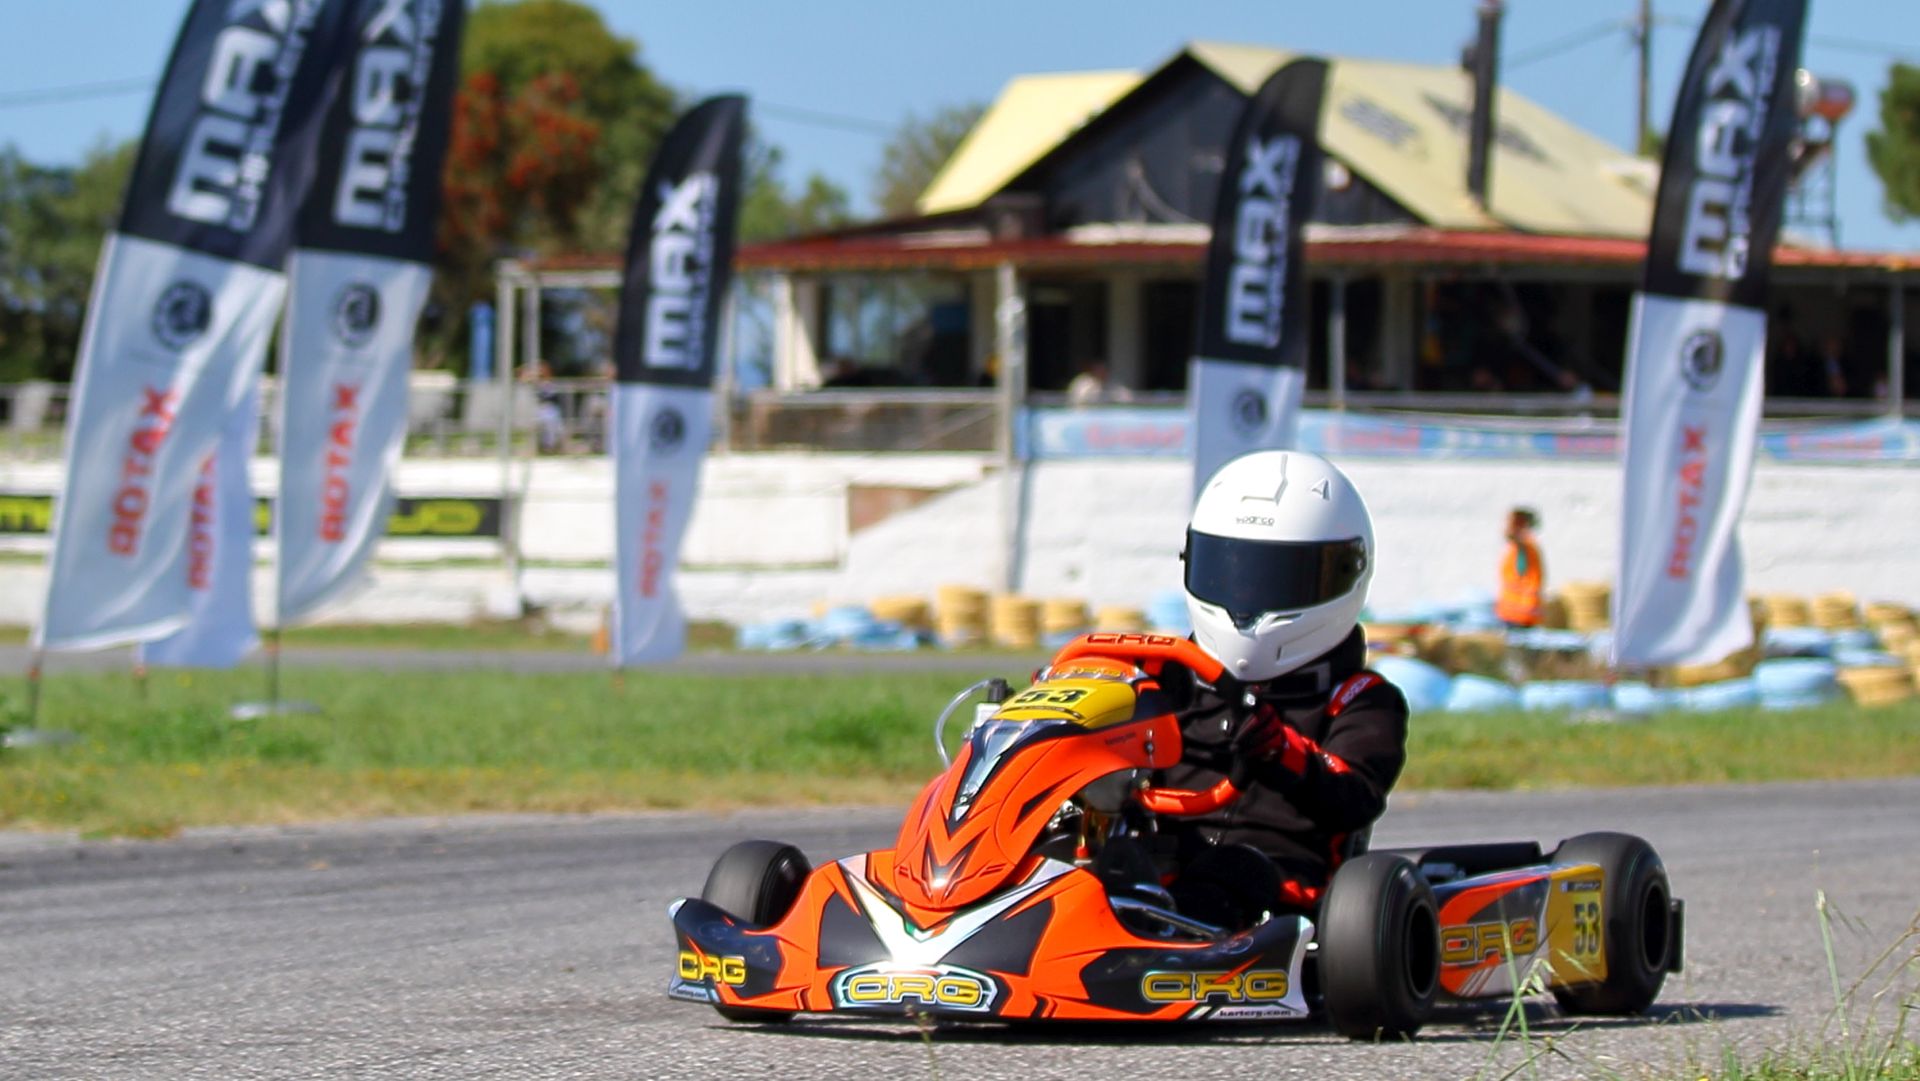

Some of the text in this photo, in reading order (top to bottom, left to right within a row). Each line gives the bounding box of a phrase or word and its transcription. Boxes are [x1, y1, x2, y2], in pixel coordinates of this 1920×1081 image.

[1677, 25, 1763, 276] MAX
[642, 172, 712, 368] MAX
[1225, 134, 1290, 343] MAX
[109, 384, 178, 556] ROTAX
[318, 382, 361, 543] ROTAX
[1666, 424, 1707, 580] ROTAX
[1014, 689, 1089, 703] 53
[679, 951, 746, 986] CRG
[1441, 920, 1537, 964] CRG
[1574, 903, 1600, 955] 53
[848, 975, 982, 1006] CRG
[1143, 971, 1288, 1003] CRG
